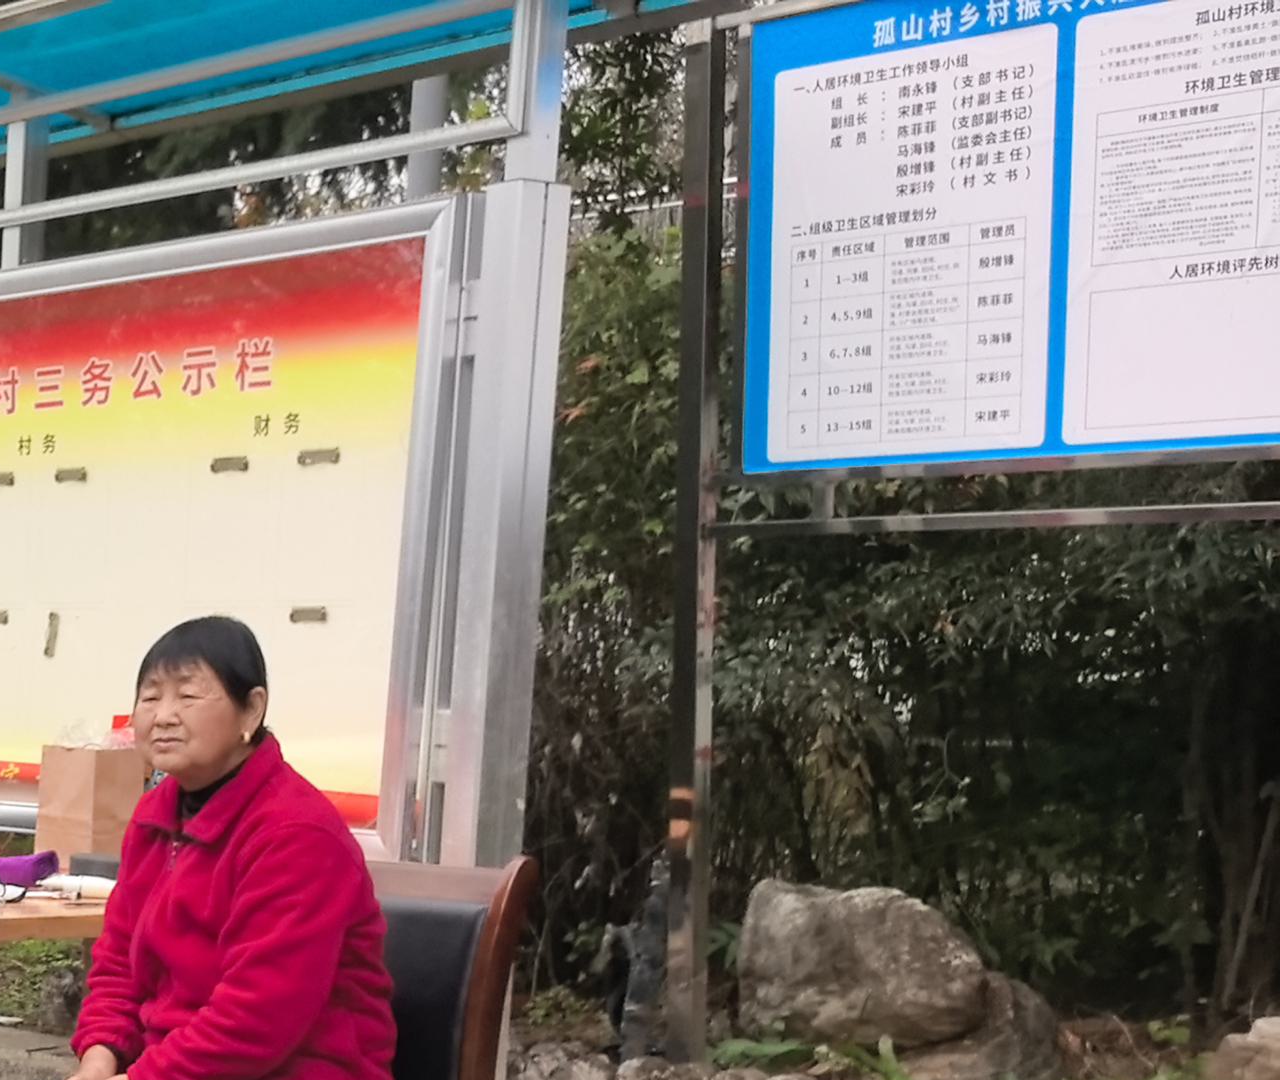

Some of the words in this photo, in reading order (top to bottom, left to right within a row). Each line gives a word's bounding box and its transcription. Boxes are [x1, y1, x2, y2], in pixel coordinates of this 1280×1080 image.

[1195, 0, 1280, 26] 孤山村环境
[793, 53, 969, 93] 一、人居环境卫生工作领导小组
[1184, 66, 1280, 95] 环境卫生管理
[897, 101, 937, 119] 宋建平
[1138, 103, 1220, 124] 环境卫生管理制度
[796, 249, 817, 262] 序号
[980, 223, 1016, 240] 管理员
[1169, 253, 1280, 280] 人居环境评先树
[252, 412, 301, 438] 财务
[17, 433, 57, 456] 村务
